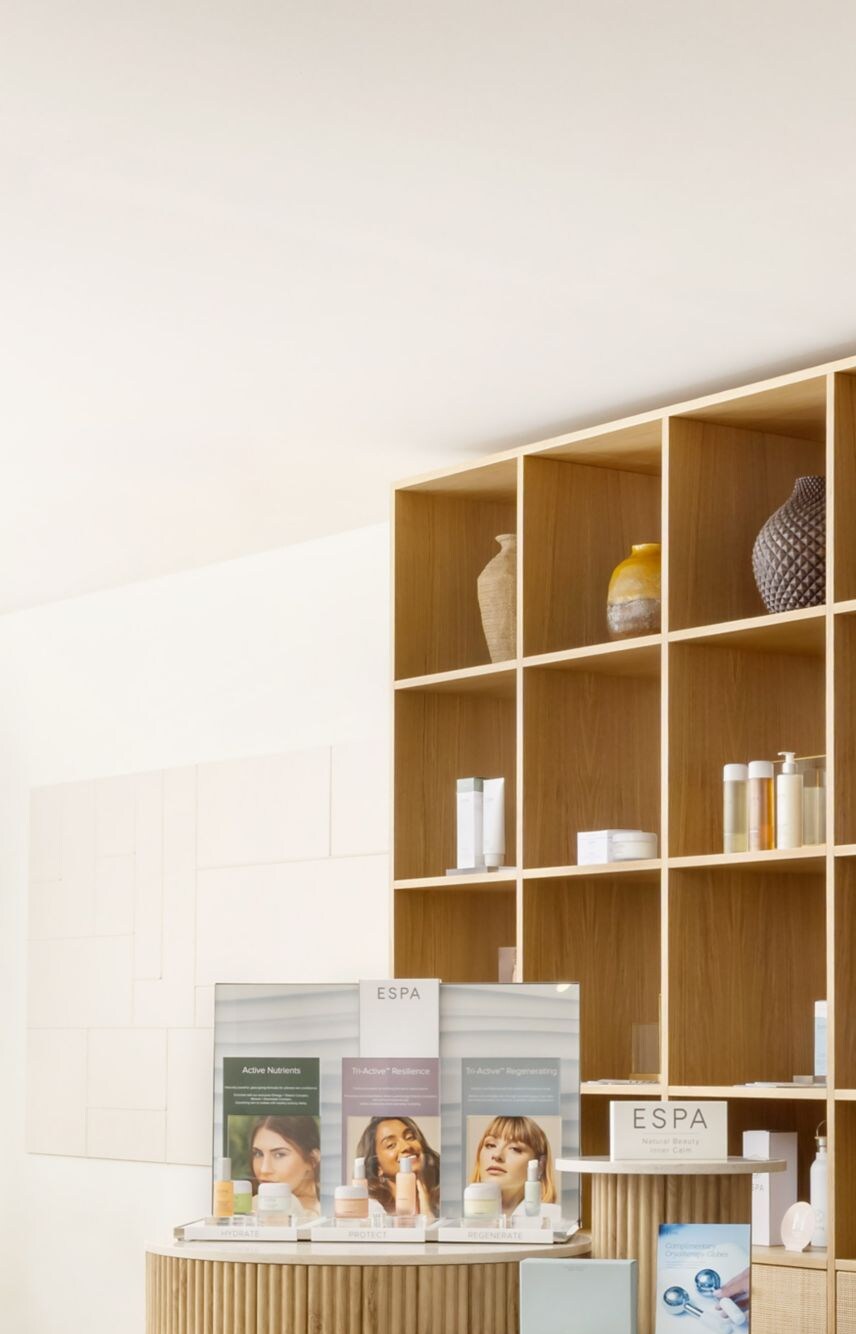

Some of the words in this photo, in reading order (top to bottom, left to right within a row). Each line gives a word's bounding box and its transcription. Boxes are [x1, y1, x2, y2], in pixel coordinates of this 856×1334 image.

[377, 986, 421, 1000] ESPA
[241, 1066, 266, 1074] Active
[267, 1066, 302, 1074] Nutrients
[391, 1067, 431, 1075] Resilience
[506, 1067, 558, 1077] Regenerating
[633, 1108, 708, 1129] ESPA
[672, 1138, 700, 1146] Beauty
[348, 1231, 387, 1239] PROTECT
